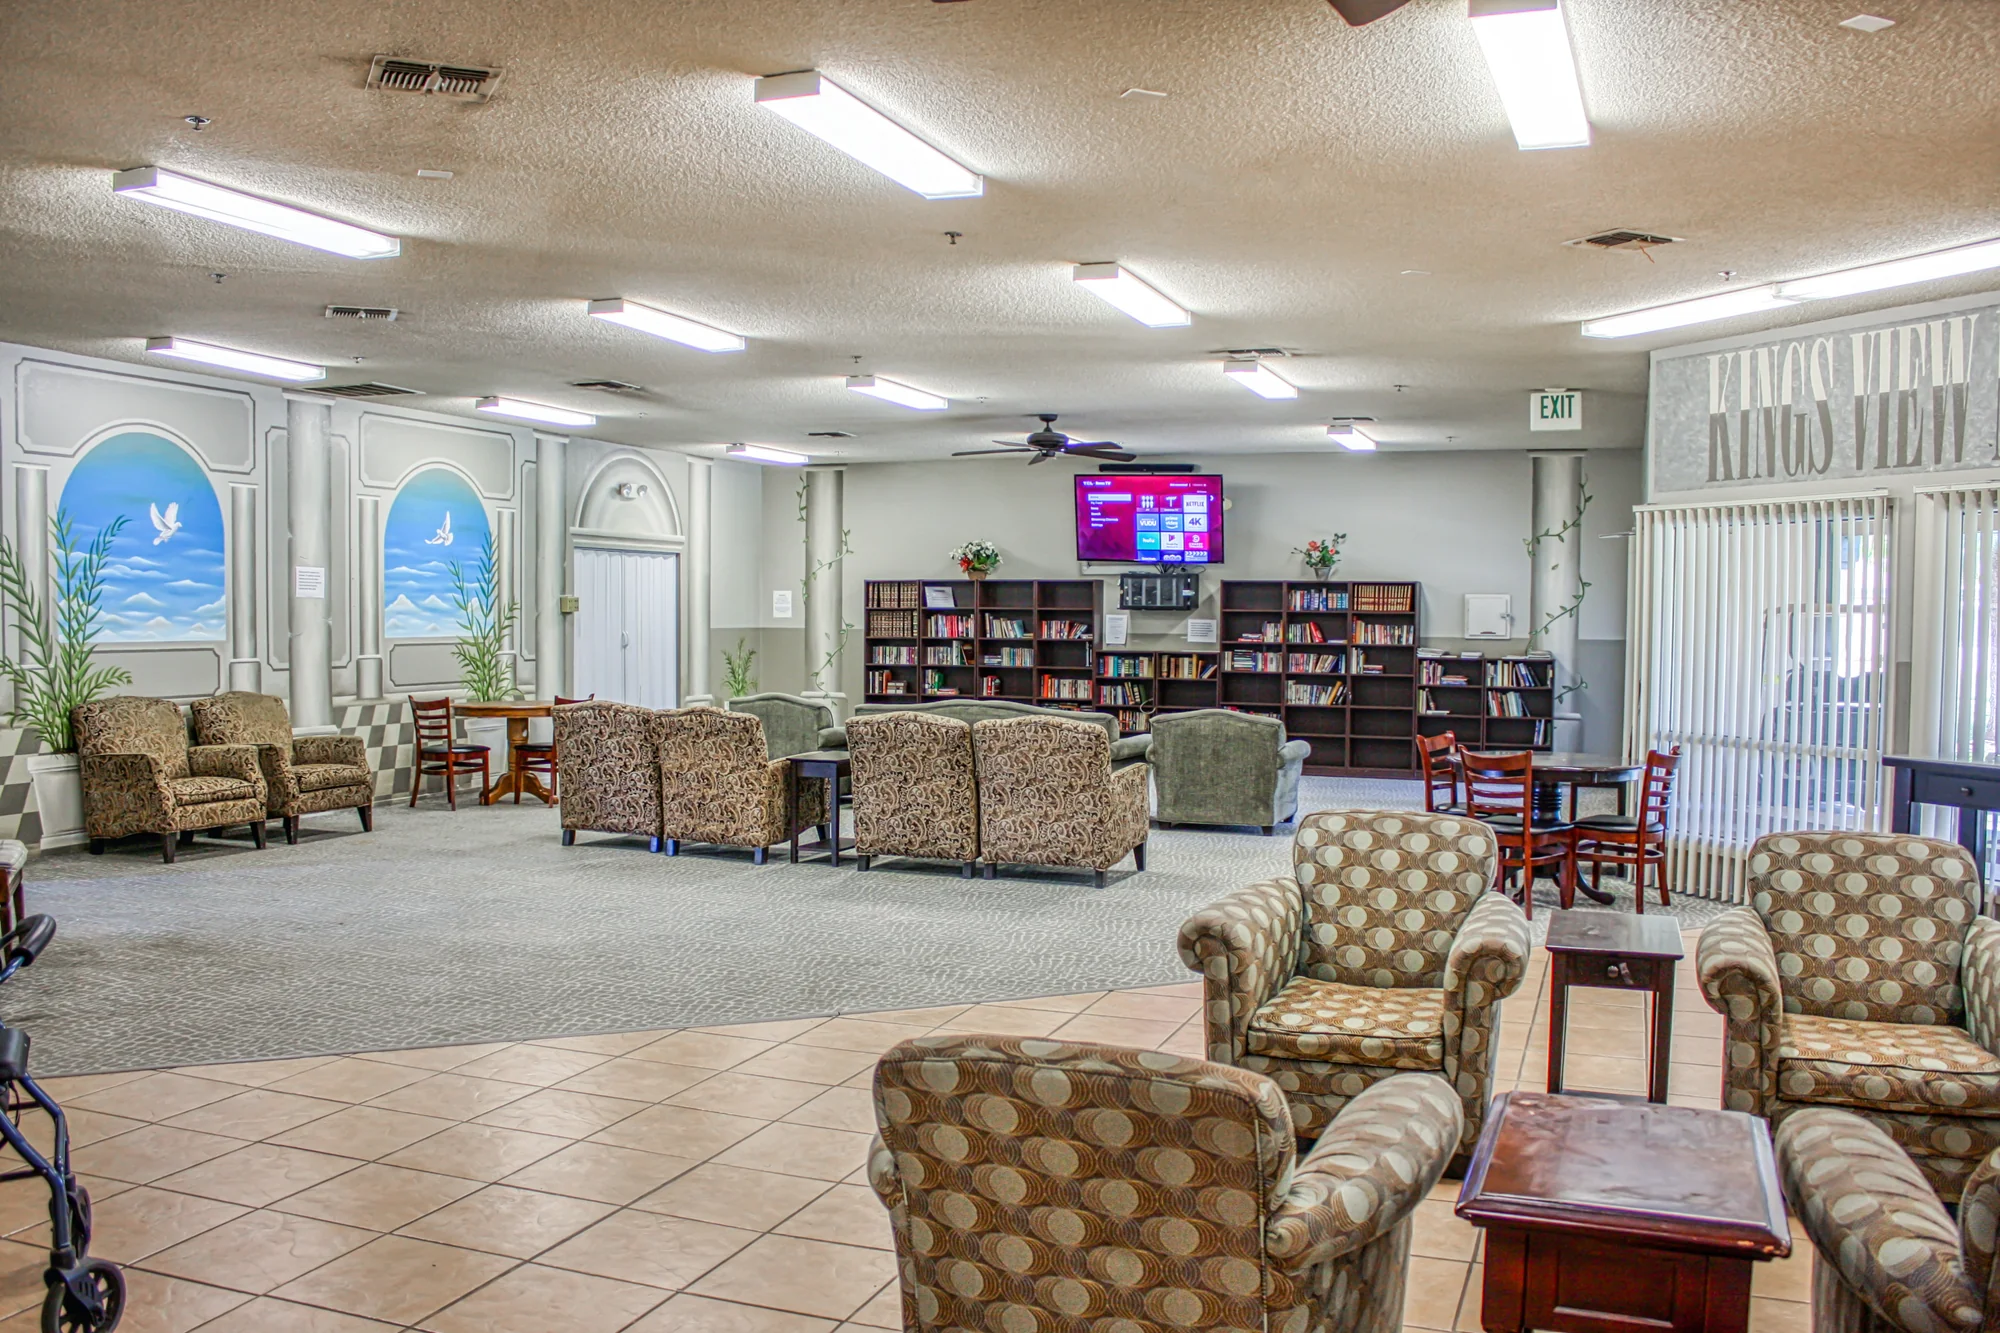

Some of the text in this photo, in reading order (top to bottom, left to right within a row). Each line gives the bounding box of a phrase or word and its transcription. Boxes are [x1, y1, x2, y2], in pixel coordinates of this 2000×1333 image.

[1540, 394, 1575, 419] EXIT
[1705, 336, 1834, 483] KINGS
[1849, 313, 1980, 471] VIEW
[1188, 517, 1202, 526] 4K
